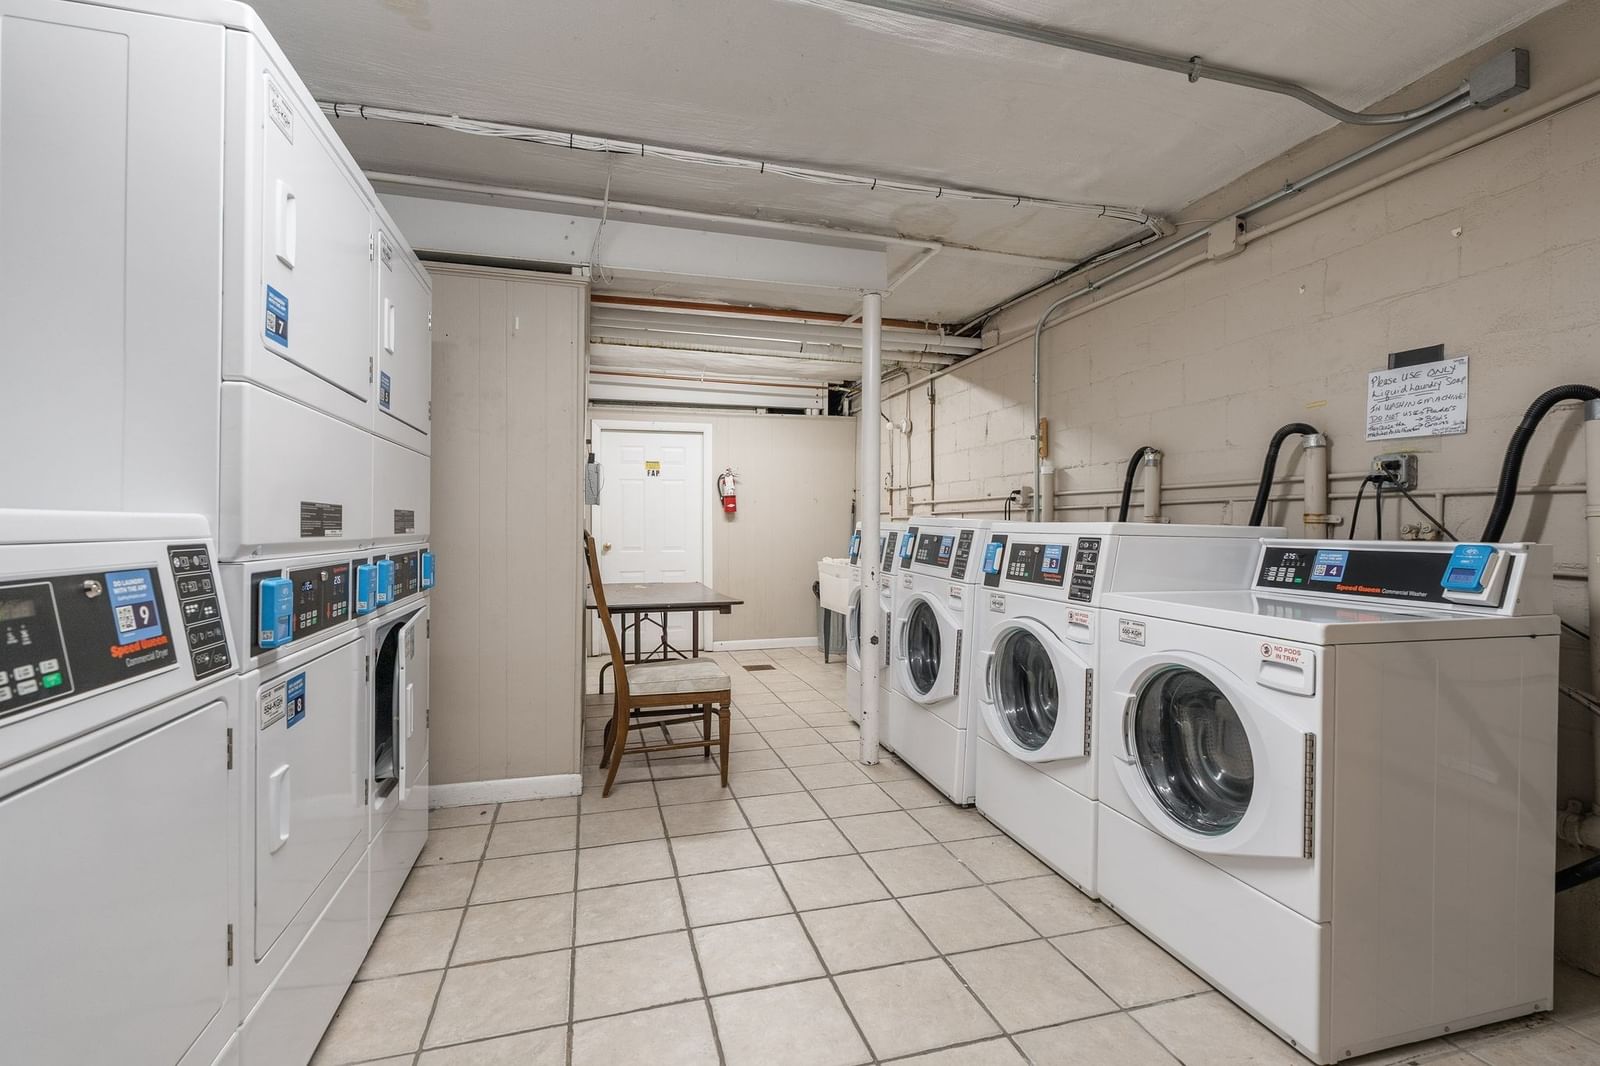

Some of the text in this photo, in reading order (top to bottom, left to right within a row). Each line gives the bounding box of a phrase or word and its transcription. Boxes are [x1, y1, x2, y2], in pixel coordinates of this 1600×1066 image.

[278, 319, 284, 335] 7
[1371, 364, 1457, 388] Please USE ONLY
[1372, 383, 1408, 400] Liquid
[1050, 559, 1057, 568] 3
[1329, 566, 1337, 576] 4
[1335, 583, 1358, 592] Speed
[1358, 585, 1381, 593] Queen
[139, 605, 150, 625] 9
[111, 635, 168, 659] Speed Queen
[1274, 645, 1302, 656] NO PODS
[1283, 655, 1299, 663] TRAY
[296, 697, 302, 712] 8
